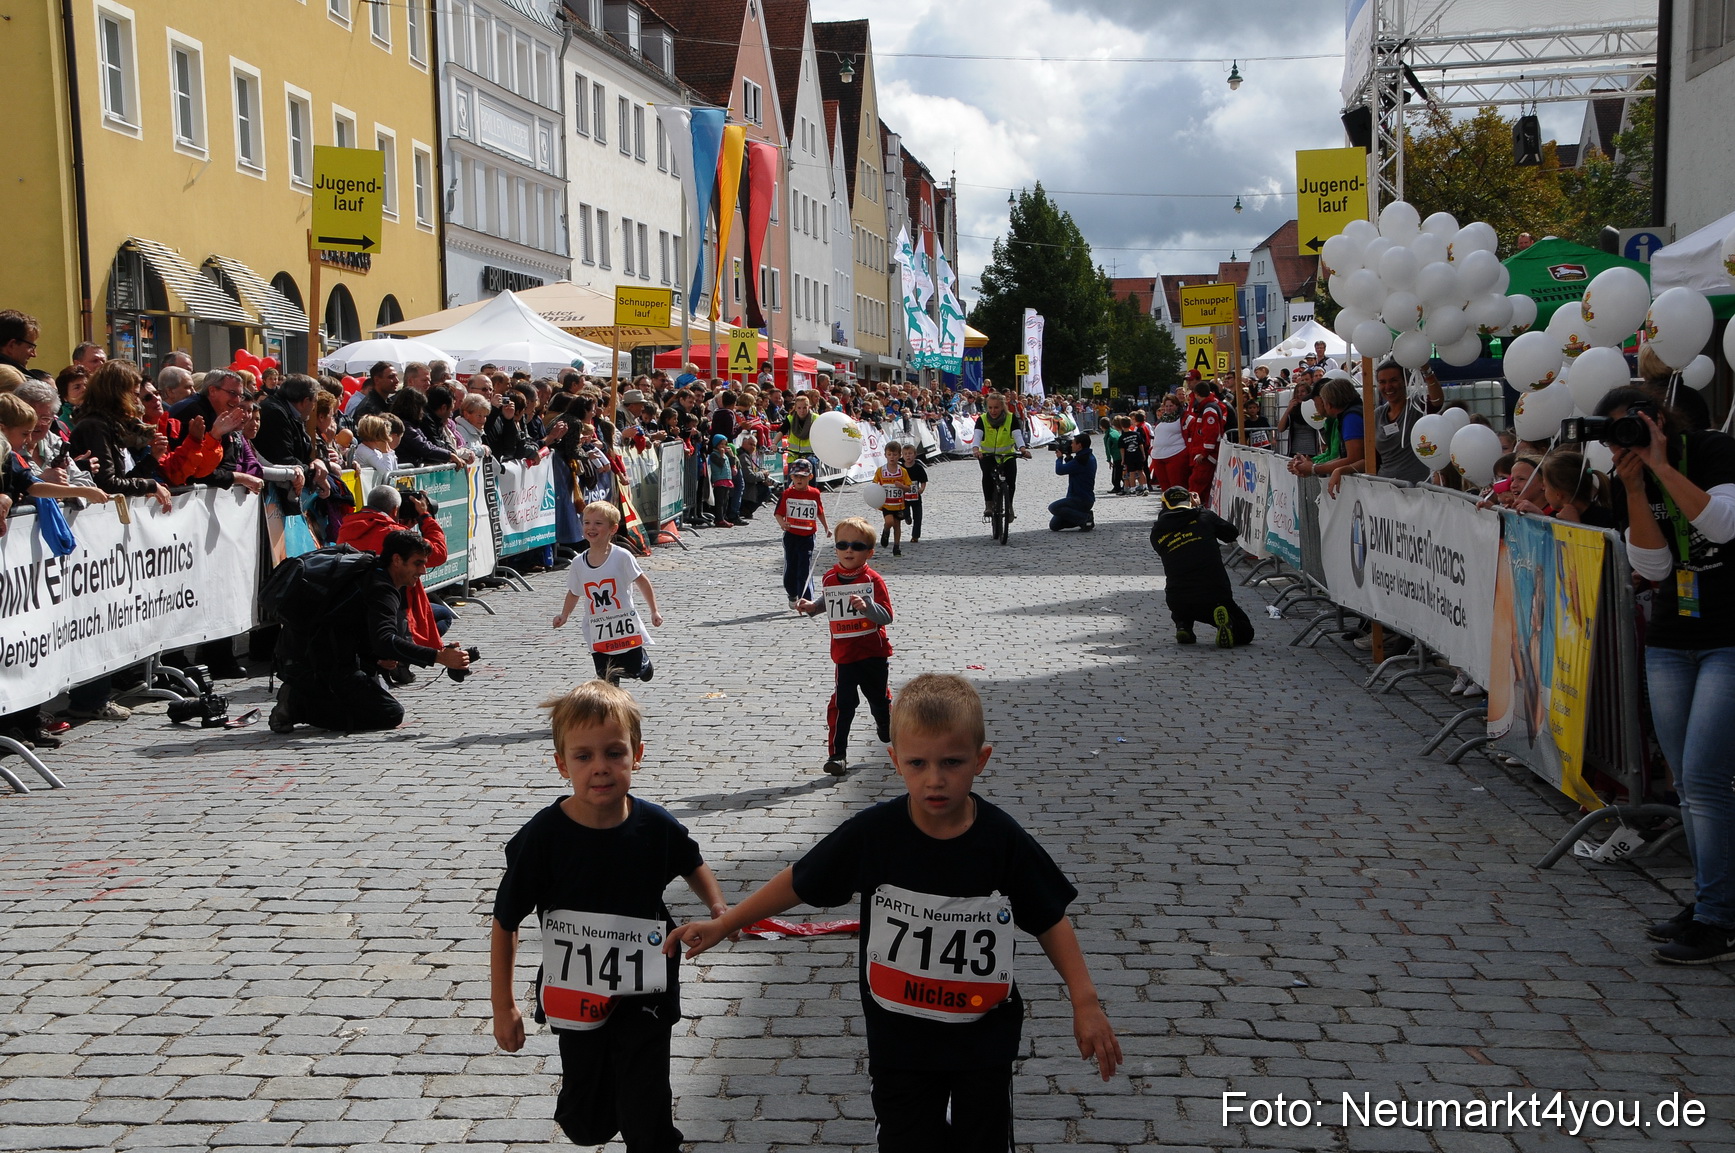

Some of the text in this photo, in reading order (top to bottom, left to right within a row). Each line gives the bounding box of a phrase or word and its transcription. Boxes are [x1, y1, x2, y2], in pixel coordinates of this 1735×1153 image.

[316, 174, 382, 195] Jugend-
[1300, 175, 1364, 197] Jugend-
[334, 195, 364, 212] lauf
[1318, 196, 1348, 213] lauf
[618, 297, 667, 309] Schnupper-
[1184, 297, 1232, 306] Schnupper-
[634, 309, 650, 318] lauf
[1201, 307, 1216, 316] lauf
[732, 330, 755, 339] Block
[1189, 336, 1213, 345] Block
[734, 342, 751, 363] A
[1194, 348, 1211, 369] A
[1019, 361, 1026, 371] B
[1219, 358, 1225, 368] B
[790, 505, 815, 518] 7149
[1369, 515, 1393, 555] BMW
[45, 533, 194, 606] EfficientDynamics
[1371, 562, 1396, 596] Weniger
[592, 590, 612, 607] M
[52, 607, 104, 651] Verbrauch.
[107, 599, 134, 632] Mehr
[135, 584, 199, 622] Fahrfreude.
[829, 599, 864, 618] 714
[590, 612, 629, 624] PARTL Neumarkt
[836, 622, 861, 632] Daniel
[595, 618, 634, 640] 7146
[605, 640, 630, 650] Fabian
[875, 895, 991, 923] PARTL Neumarkt
[545, 919, 642, 943] PARTL Neumarkt
[886, 916, 996, 976] 7143
[554, 938, 644, 991] 7141
[904, 980, 968, 1008] Niclas
